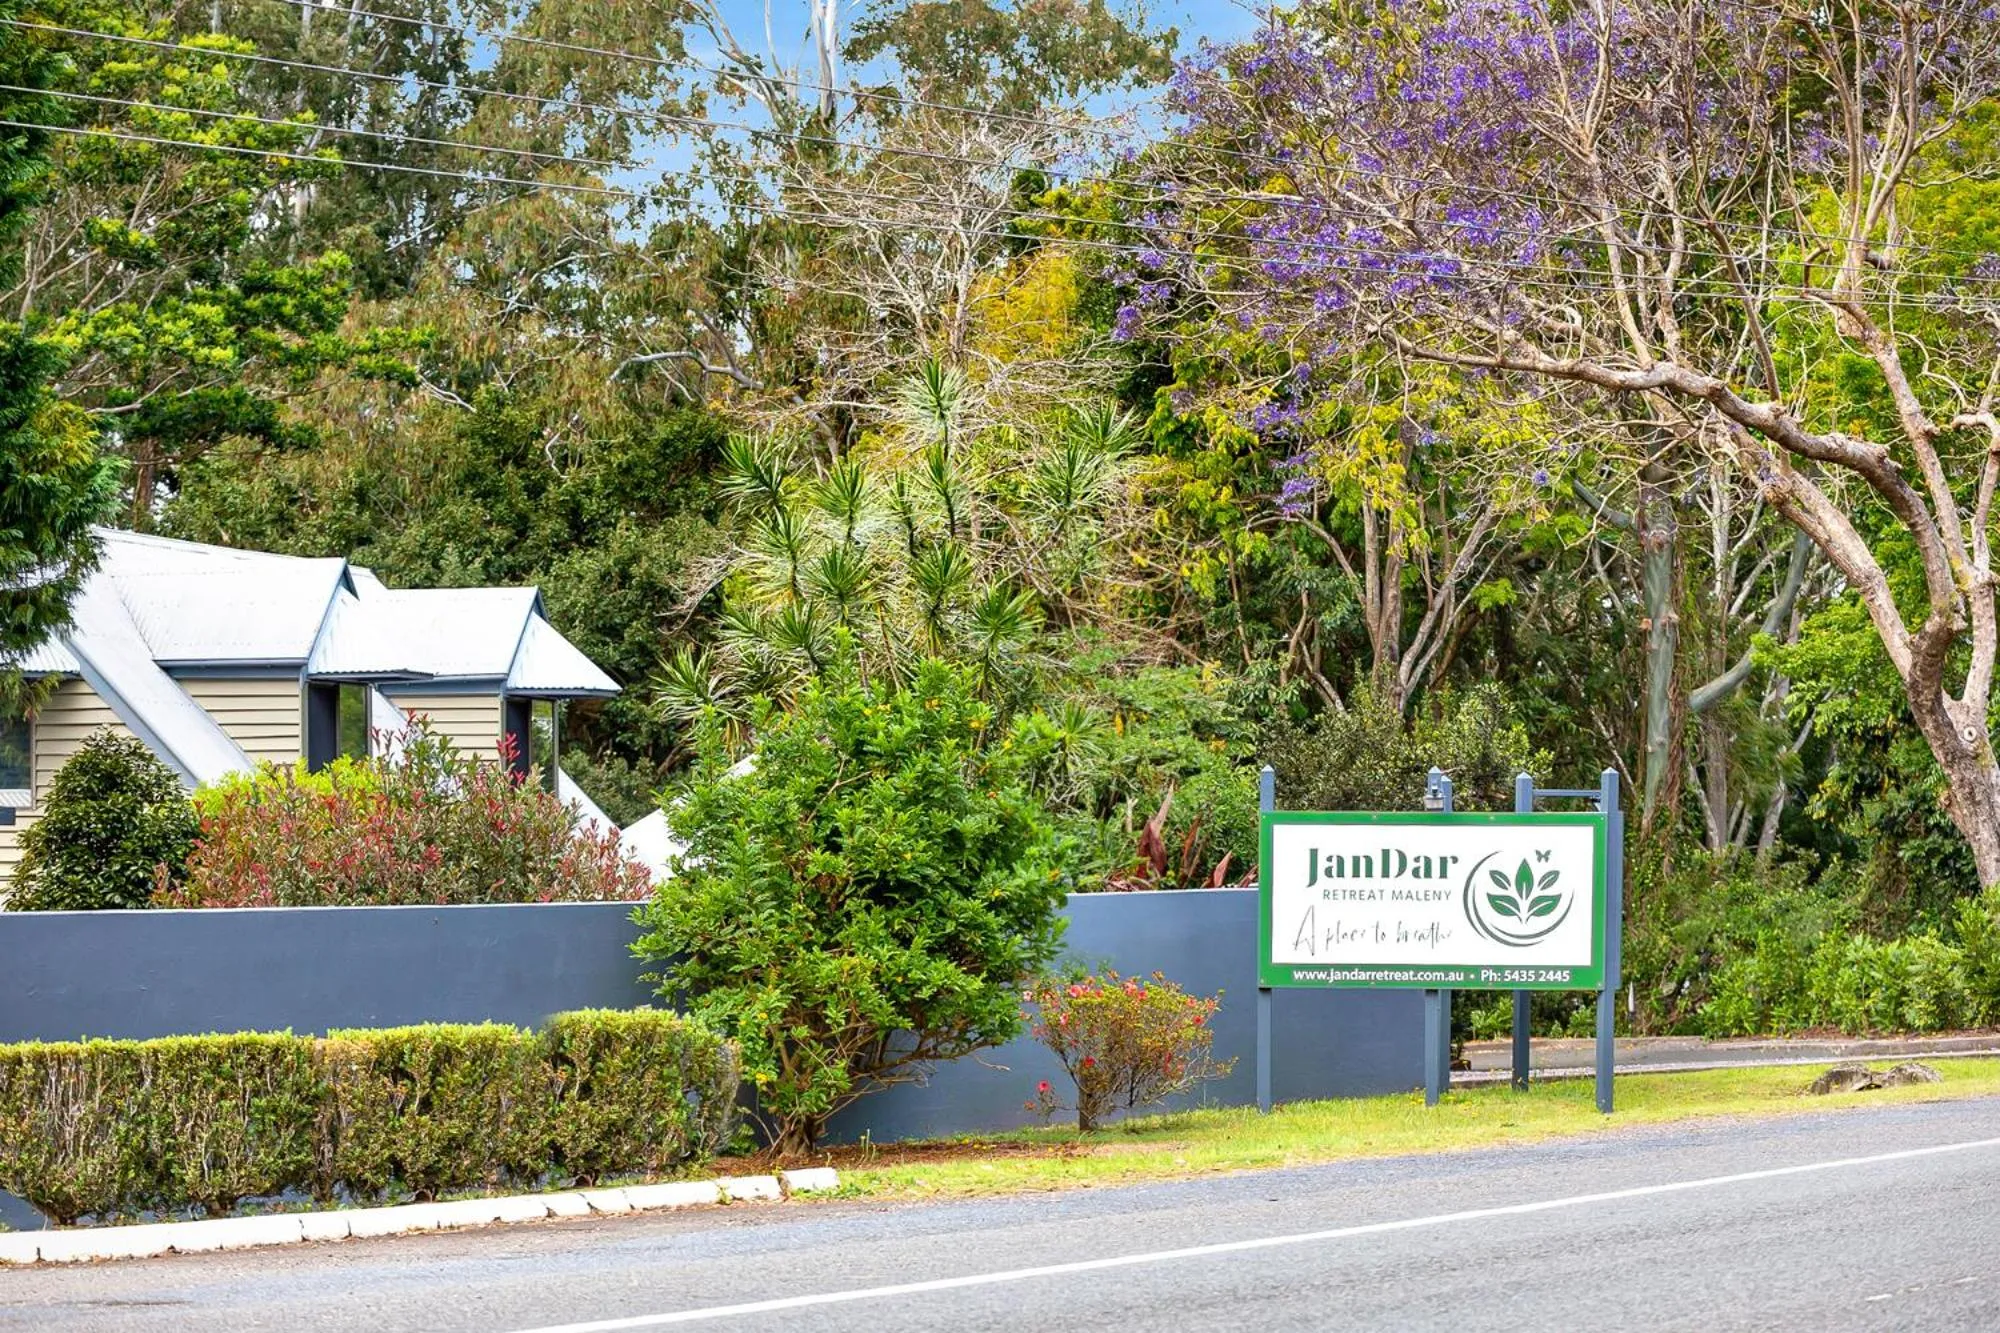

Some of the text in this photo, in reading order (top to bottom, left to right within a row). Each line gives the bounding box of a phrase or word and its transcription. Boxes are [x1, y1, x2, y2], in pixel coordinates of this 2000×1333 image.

[1306, 848, 1459, 888] JanDar
[1323, 889, 1452, 901] RETREAT MALENY
[1292, 904, 1316, 957] A
[1371, 920, 1387, 944] to
[1293, 968, 1571, 983] www.jandarretreat.com.au Ph: 5435 2445
